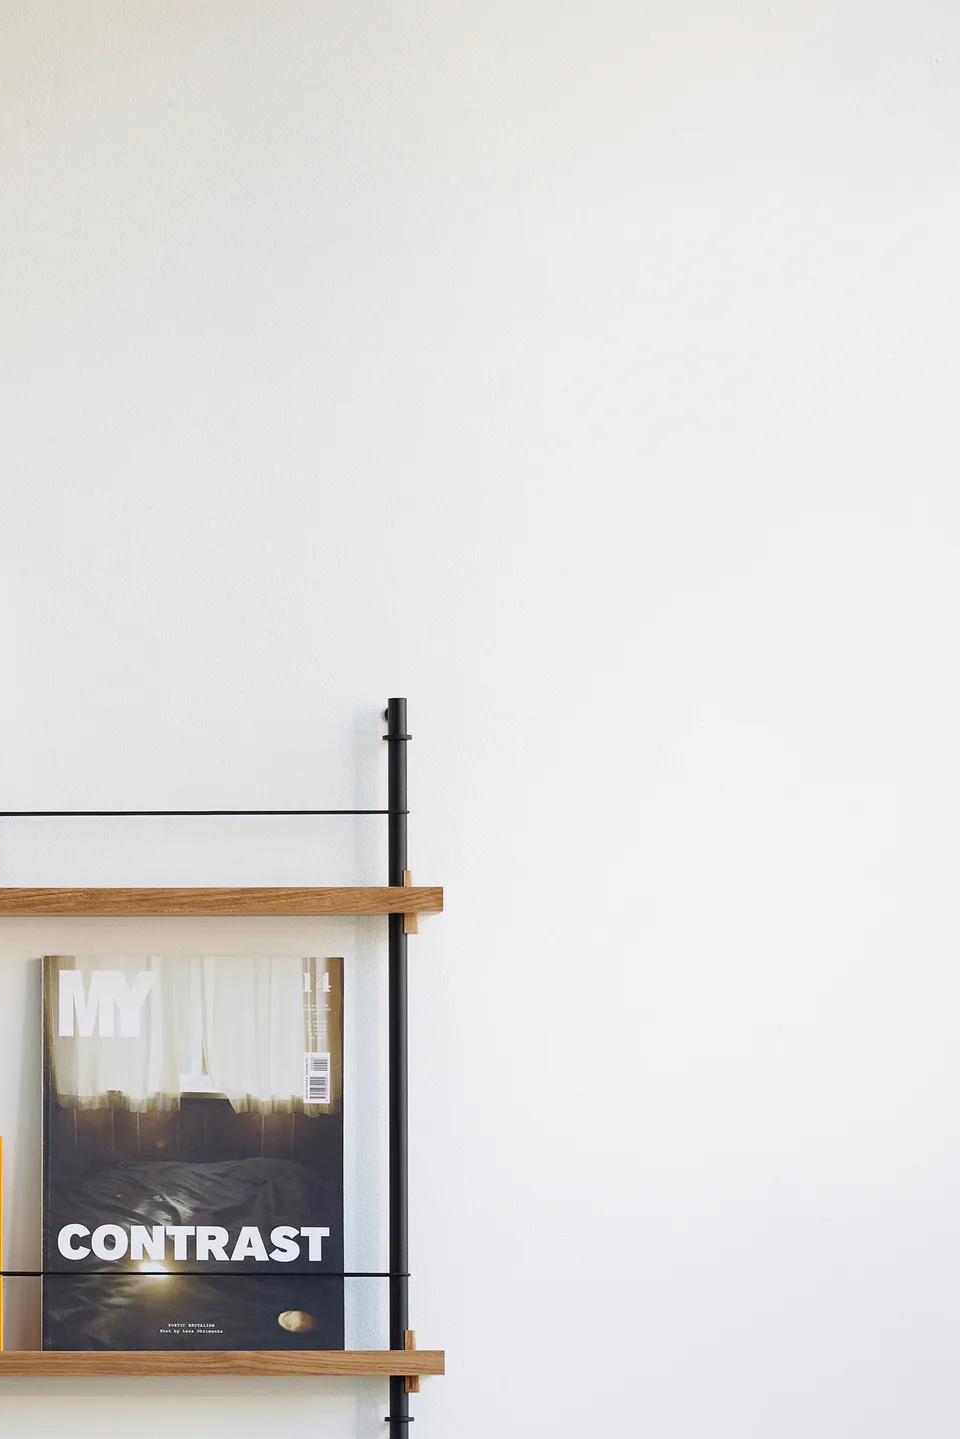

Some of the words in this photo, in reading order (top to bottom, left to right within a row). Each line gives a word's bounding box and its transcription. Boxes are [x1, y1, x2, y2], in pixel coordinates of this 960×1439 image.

[302, 972, 332, 993] 14
[58, 969, 157, 1038] MY
[57, 1223, 330, 1263] CONTRAST
